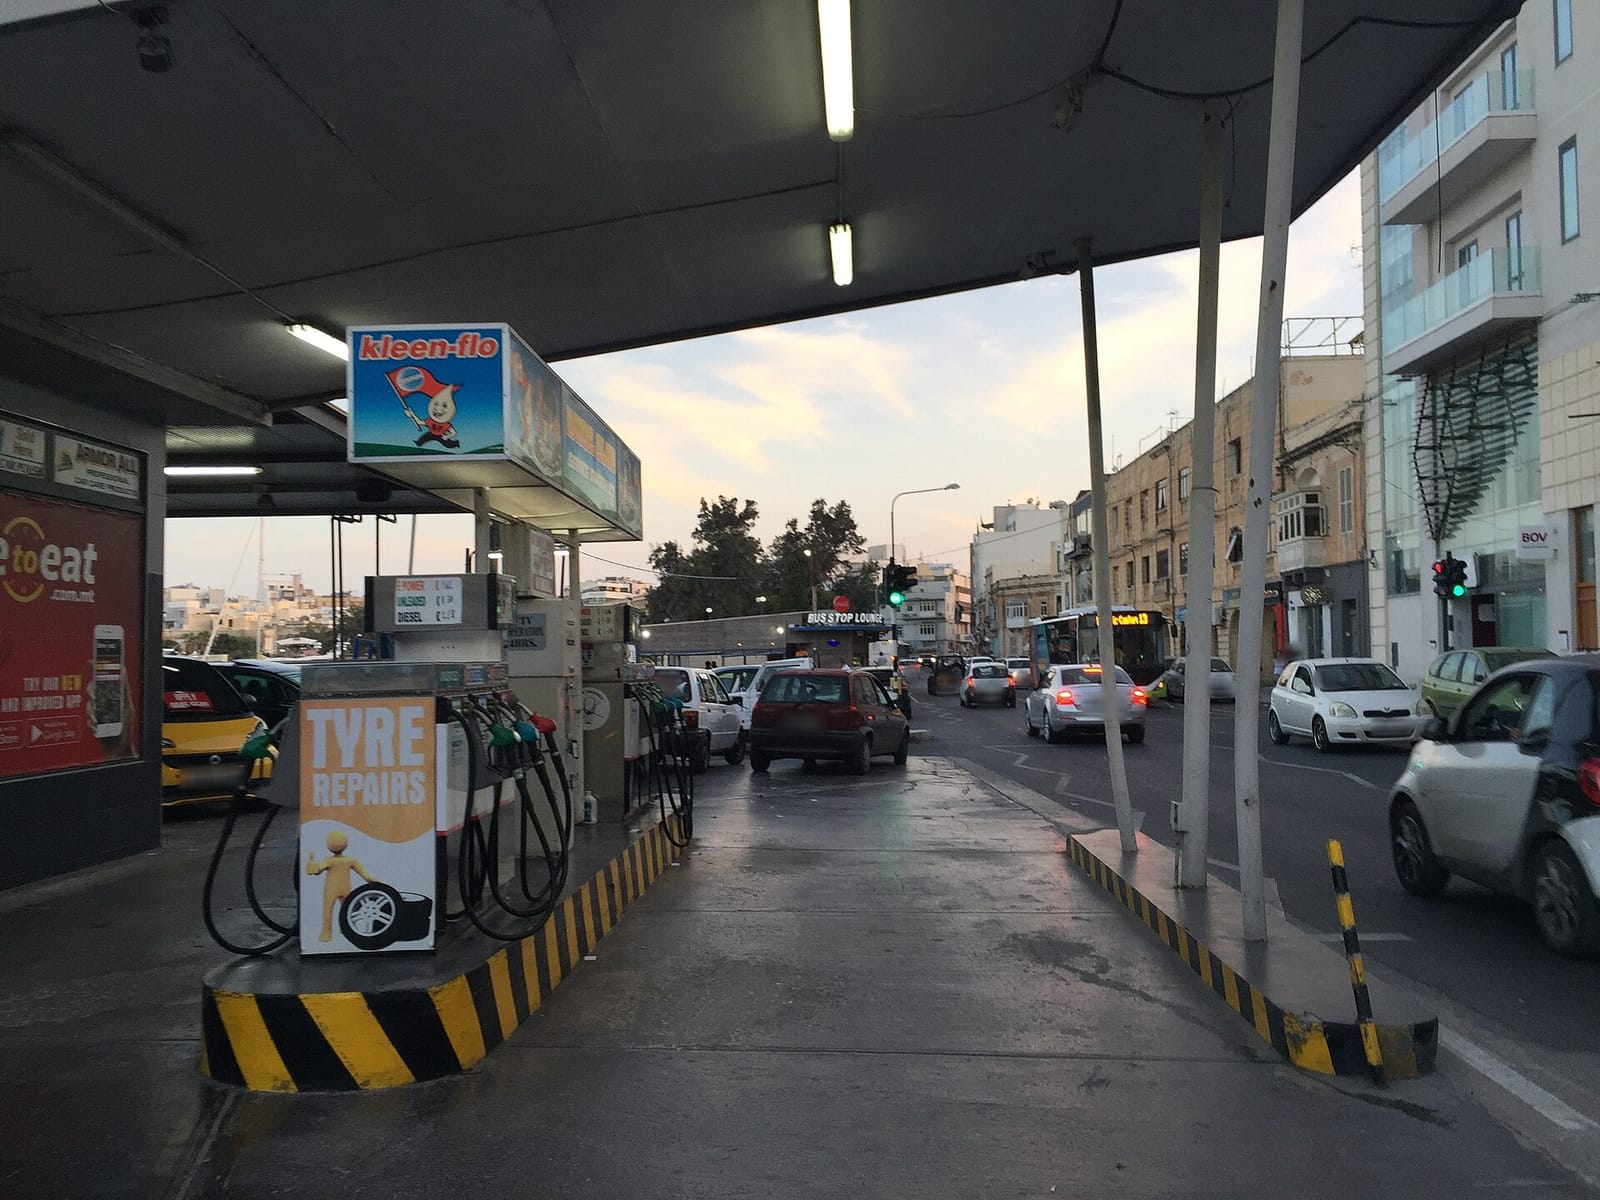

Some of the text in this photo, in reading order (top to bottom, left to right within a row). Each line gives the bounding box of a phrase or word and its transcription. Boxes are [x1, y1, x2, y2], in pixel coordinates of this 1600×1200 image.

[359, 332, 499, 360] kleen-flo
[1522, 532, 1548, 543] BOV
[12, 544, 38, 574] to
[40, 542, 98, 585] eat
[397, 611, 423, 623] DIESEL
[807, 612, 884, 624] BUS STOP LOUNGE
[306, 705, 425, 769] TYRE
[312, 770, 426, 807] REPAIRS
